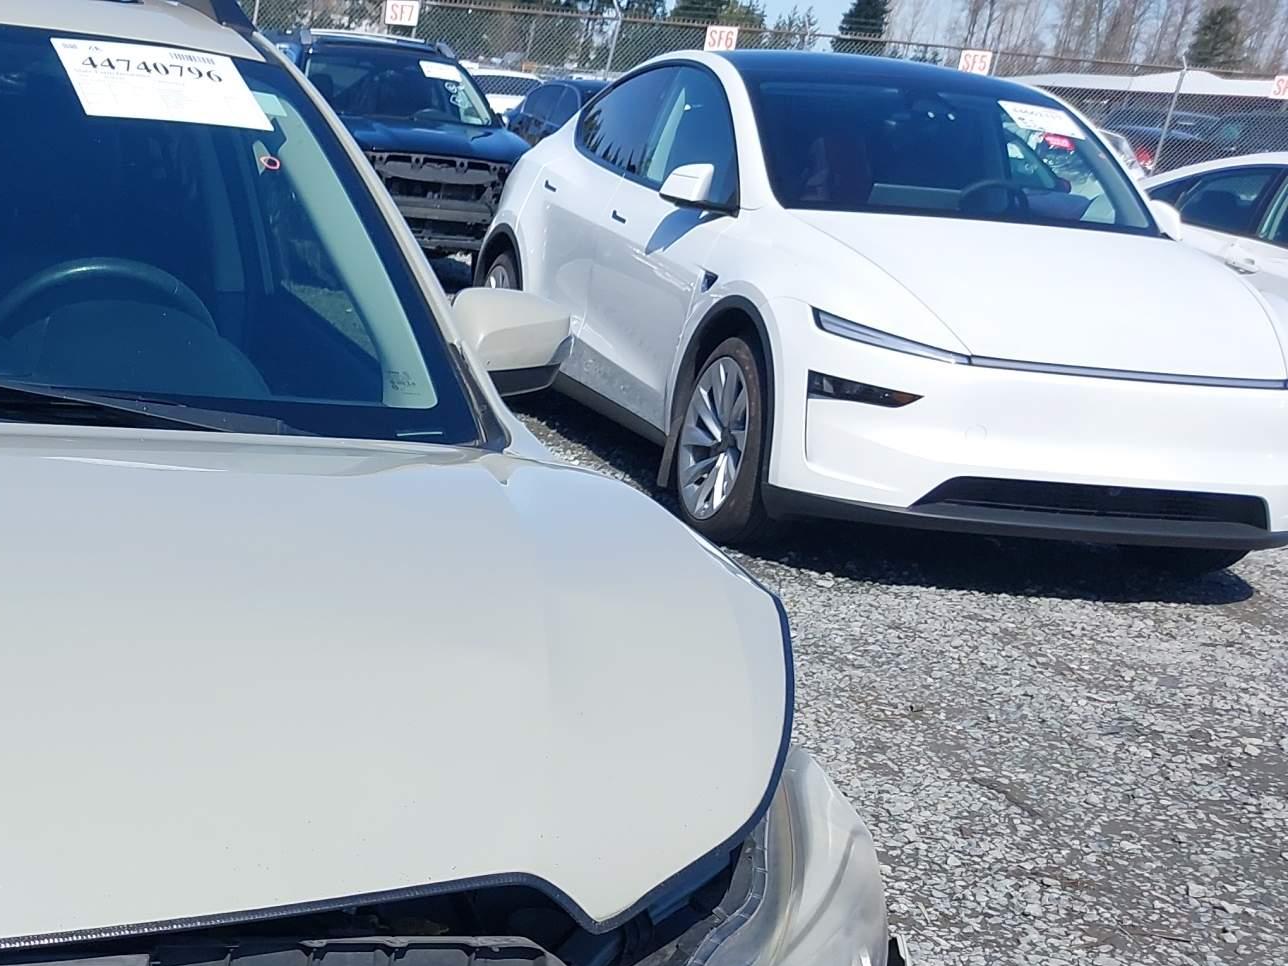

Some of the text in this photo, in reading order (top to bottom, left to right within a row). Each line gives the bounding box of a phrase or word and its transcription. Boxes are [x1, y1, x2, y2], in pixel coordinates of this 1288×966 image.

[390, 3, 414, 22] SF7
[708, 30, 734, 49] SF6
[81, 56, 223, 83] 44740796
[963, 53, 988, 71] SF5
